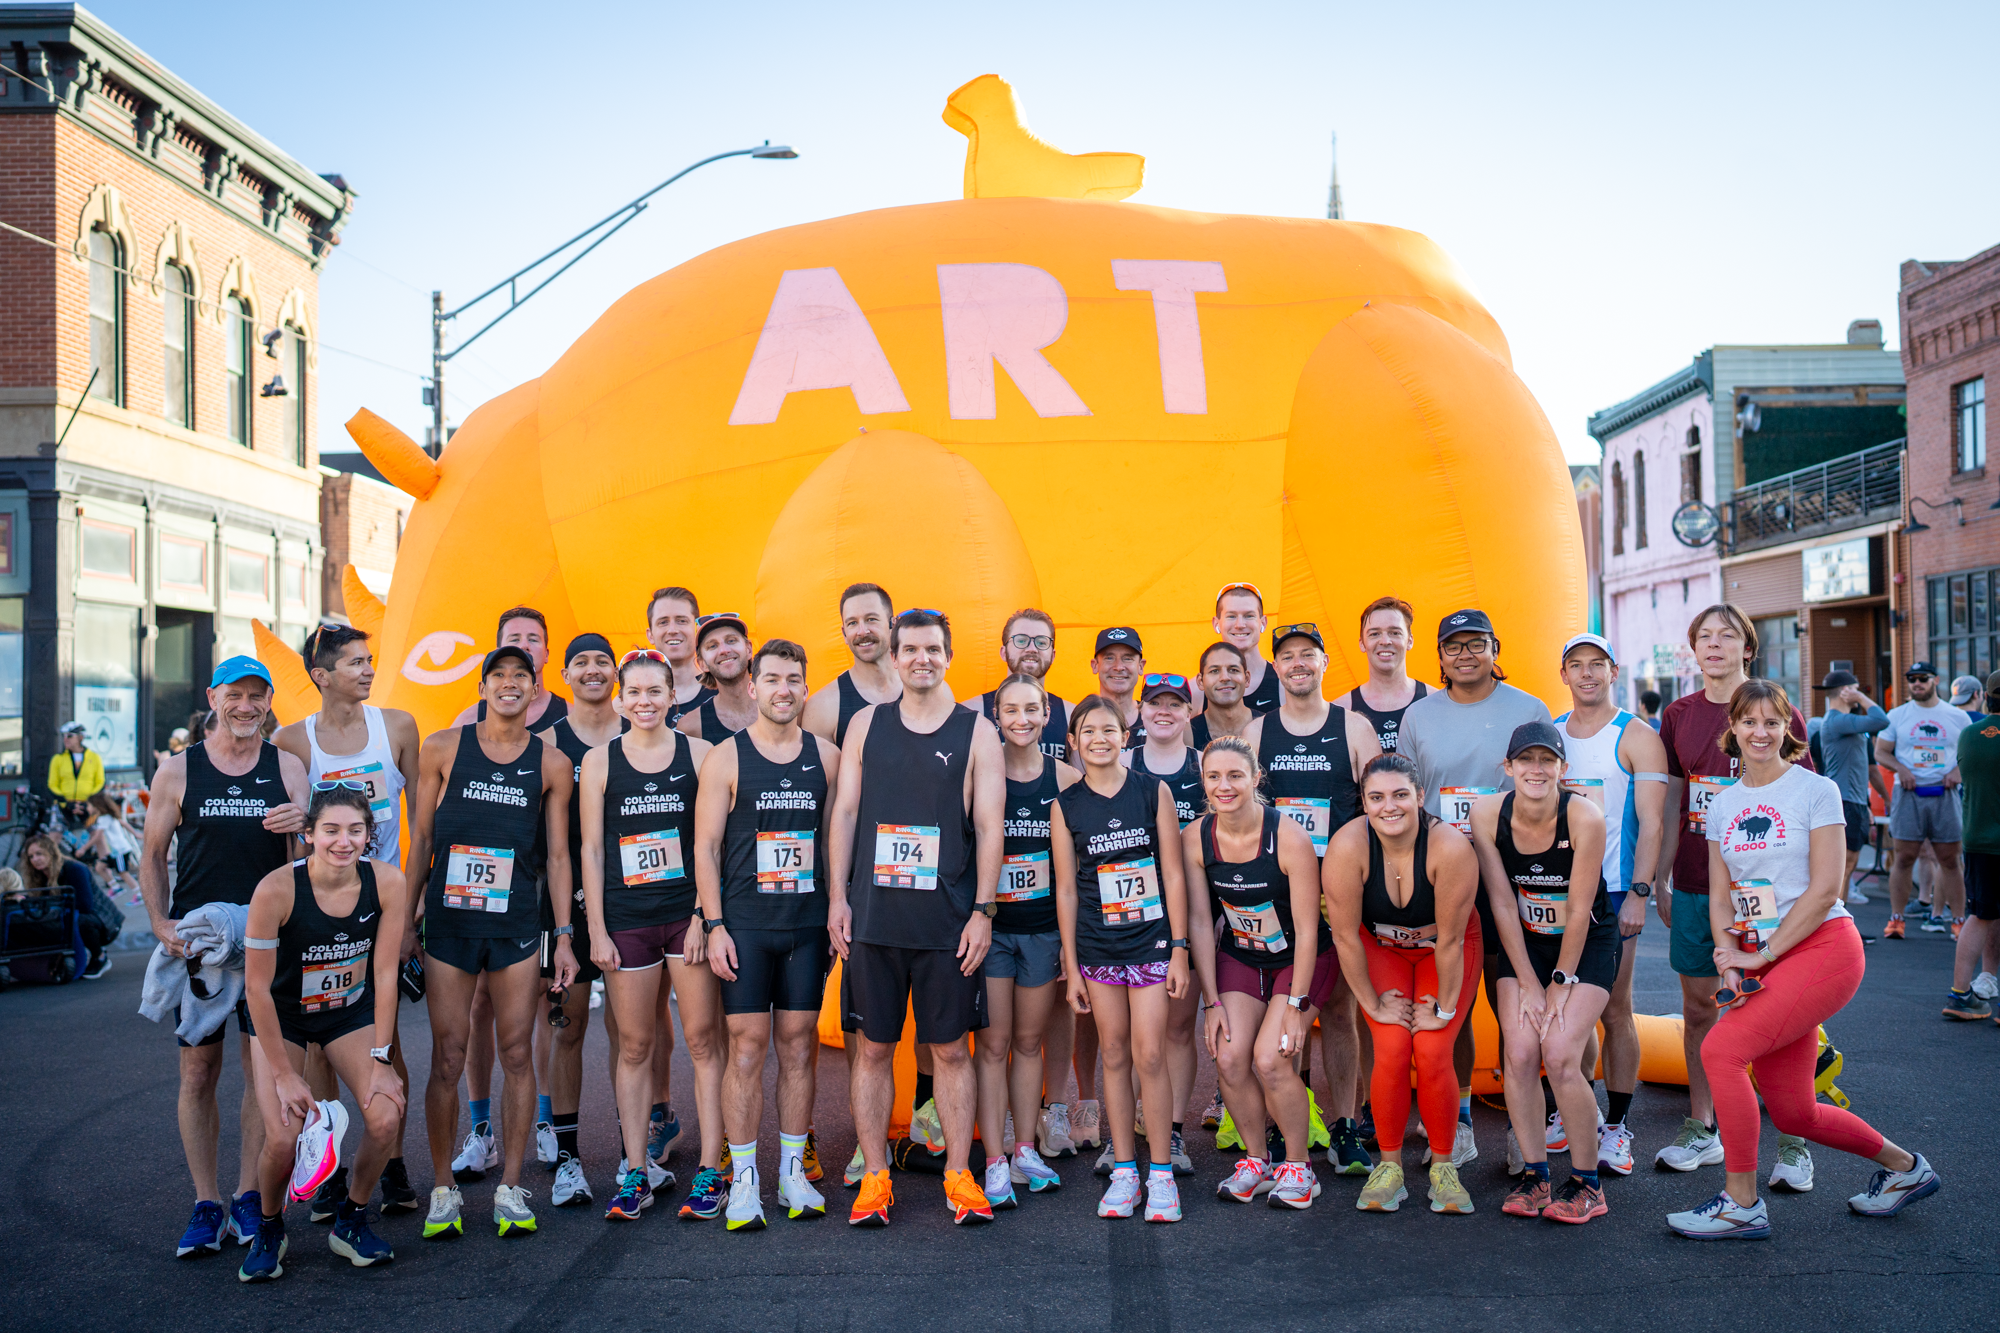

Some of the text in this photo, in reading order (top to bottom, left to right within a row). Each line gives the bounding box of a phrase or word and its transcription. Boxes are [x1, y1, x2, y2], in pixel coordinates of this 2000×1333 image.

[728, 258, 1228, 426] ART
[1274, 754, 1327, 762] COLORADO
[1920, 752, 1939, 763] 560
[1270, 761, 1332, 771] HARRIERS
[469, 781, 524, 796] COLORADO
[760, 791, 812, 800] COLORADO
[205, 798, 266, 807] COLORADO
[462, 788, 528, 807] HARRIERS
[624, 793, 680, 805] COLORADO
[755, 799, 817, 811] HARRIERS
[1695, 790, 1720, 810] 45
[620, 801, 685, 816] HARRIERS
[1454, 801, 1475, 820] 19
[1004, 820, 1051, 829] OLORADO
[1723, 807, 1751, 846] RIVER
[1756, 804, 1786, 839] NORTH
[1089, 827, 1146, 844] COLORADO
[892, 842, 923, 863] 194
[1087, 834, 1151, 855] HARRIERS
[1557, 840, 1569, 849] NB
[1734, 841, 1767, 853] 5000
[637, 847, 667, 870] 201
[773, 847, 802, 868] 175
[465, 863, 496, 884] 195
[1008, 870, 1036, 890] 182
[1115, 876, 1146, 899] 173
[1214, 880, 1240, 888] COLORADO
[1526, 905, 1556, 924] 190
[1392, 929, 1422, 941] 192
[309, 938, 370, 952] COLORADO
[321, 971, 352, 991] 618
